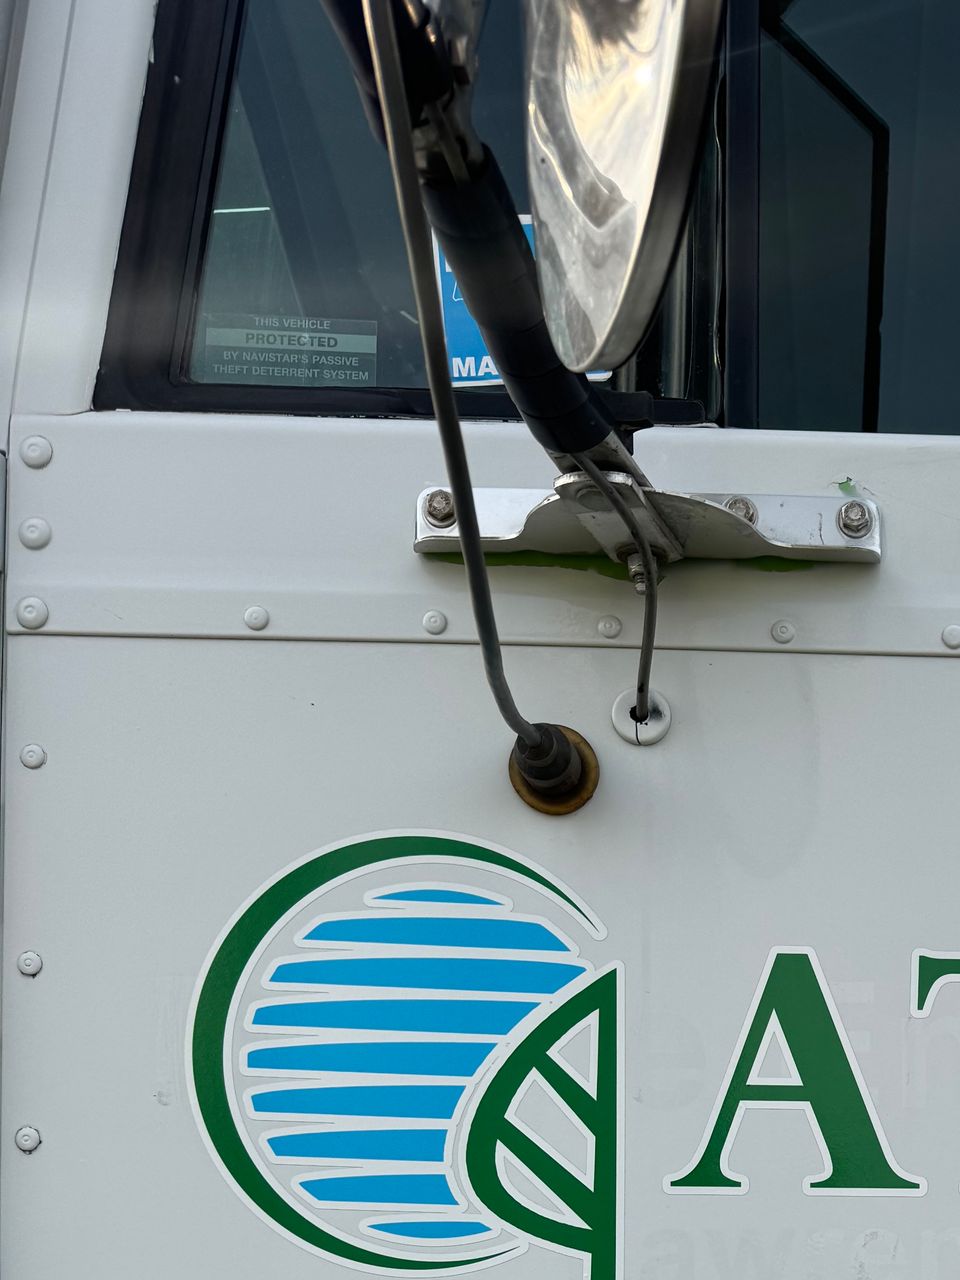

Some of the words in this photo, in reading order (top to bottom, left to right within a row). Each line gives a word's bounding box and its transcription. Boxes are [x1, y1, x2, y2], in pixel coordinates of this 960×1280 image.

[254, 317, 279, 327] THIS
[283, 318, 331, 330] VEHICLE
[245, 333, 338, 348] PROTECTED
[223, 351, 238, 361] BY
[242, 352, 309, 364] NAVISTAR'S
[312, 355, 359, 366] PASSIVE
[212, 364, 249, 375] THEFT
[252, 365, 320, 379] DETERRENT
[323, 369, 369, 380] SYSTEM
